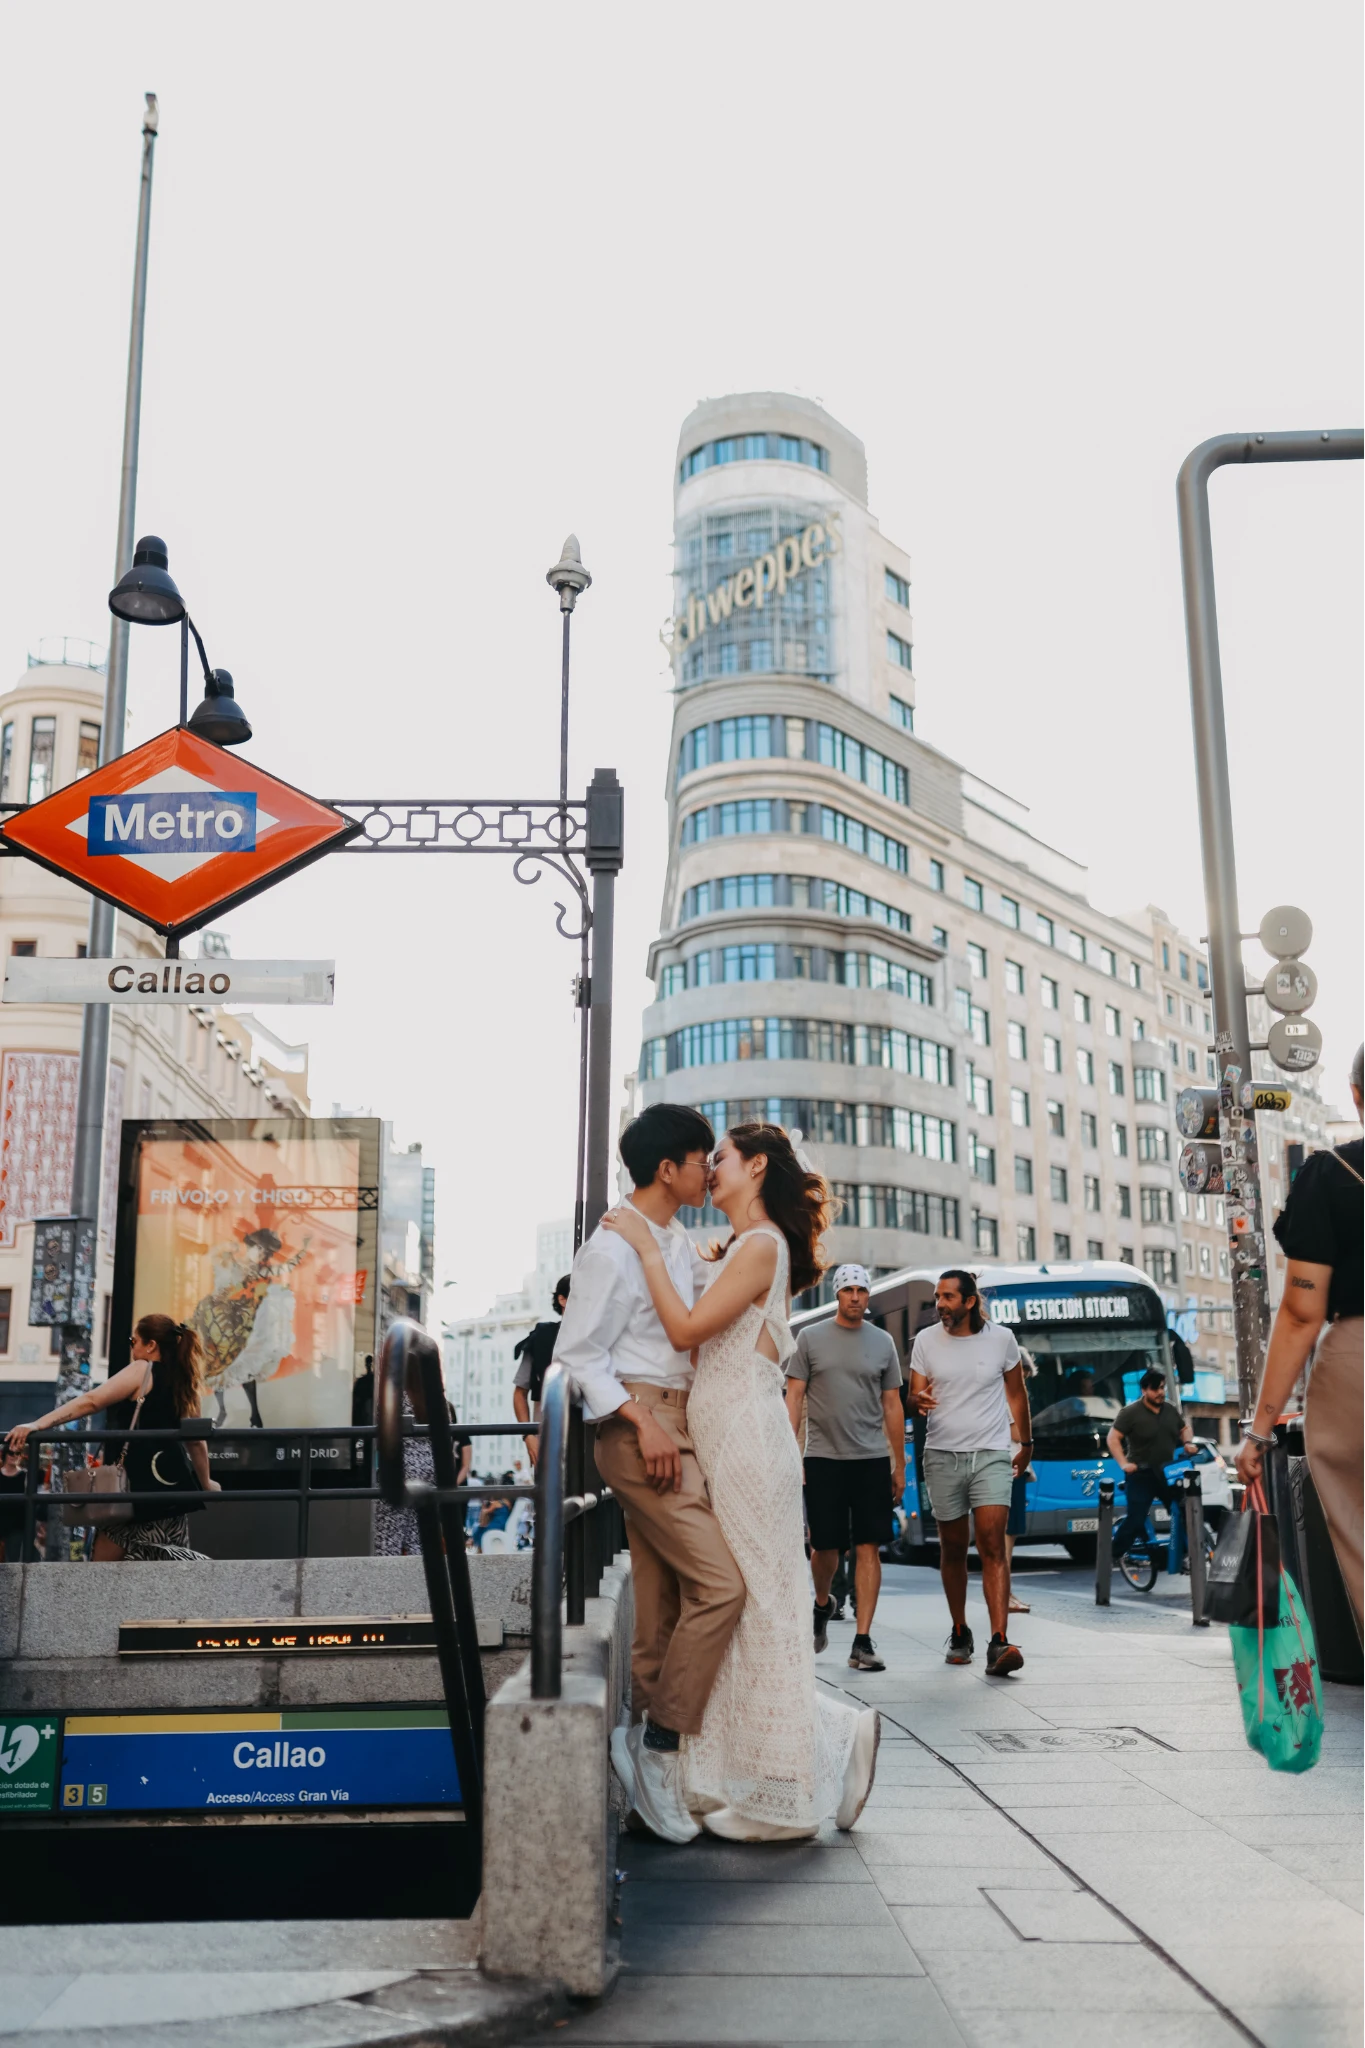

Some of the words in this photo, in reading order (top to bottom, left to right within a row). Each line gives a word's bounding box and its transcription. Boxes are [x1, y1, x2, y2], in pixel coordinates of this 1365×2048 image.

[104, 803, 243, 842] Metro
[107, 965, 231, 994] Callao
[234, 1190, 246, 1203] Y
[990, 1299, 1021, 1323] 001
[1085, 1296, 1129, 1318] ATOCHA
[291, 1448, 340, 1459] MDRID
[233, 1741, 326, 1769] Callao
[68, 1787, 79, 1803] 3
[92, 1787, 103, 1803] 5
[206, 1791, 295, 1804] Acceso/Access
[298, 1790, 327, 1802] Gran
